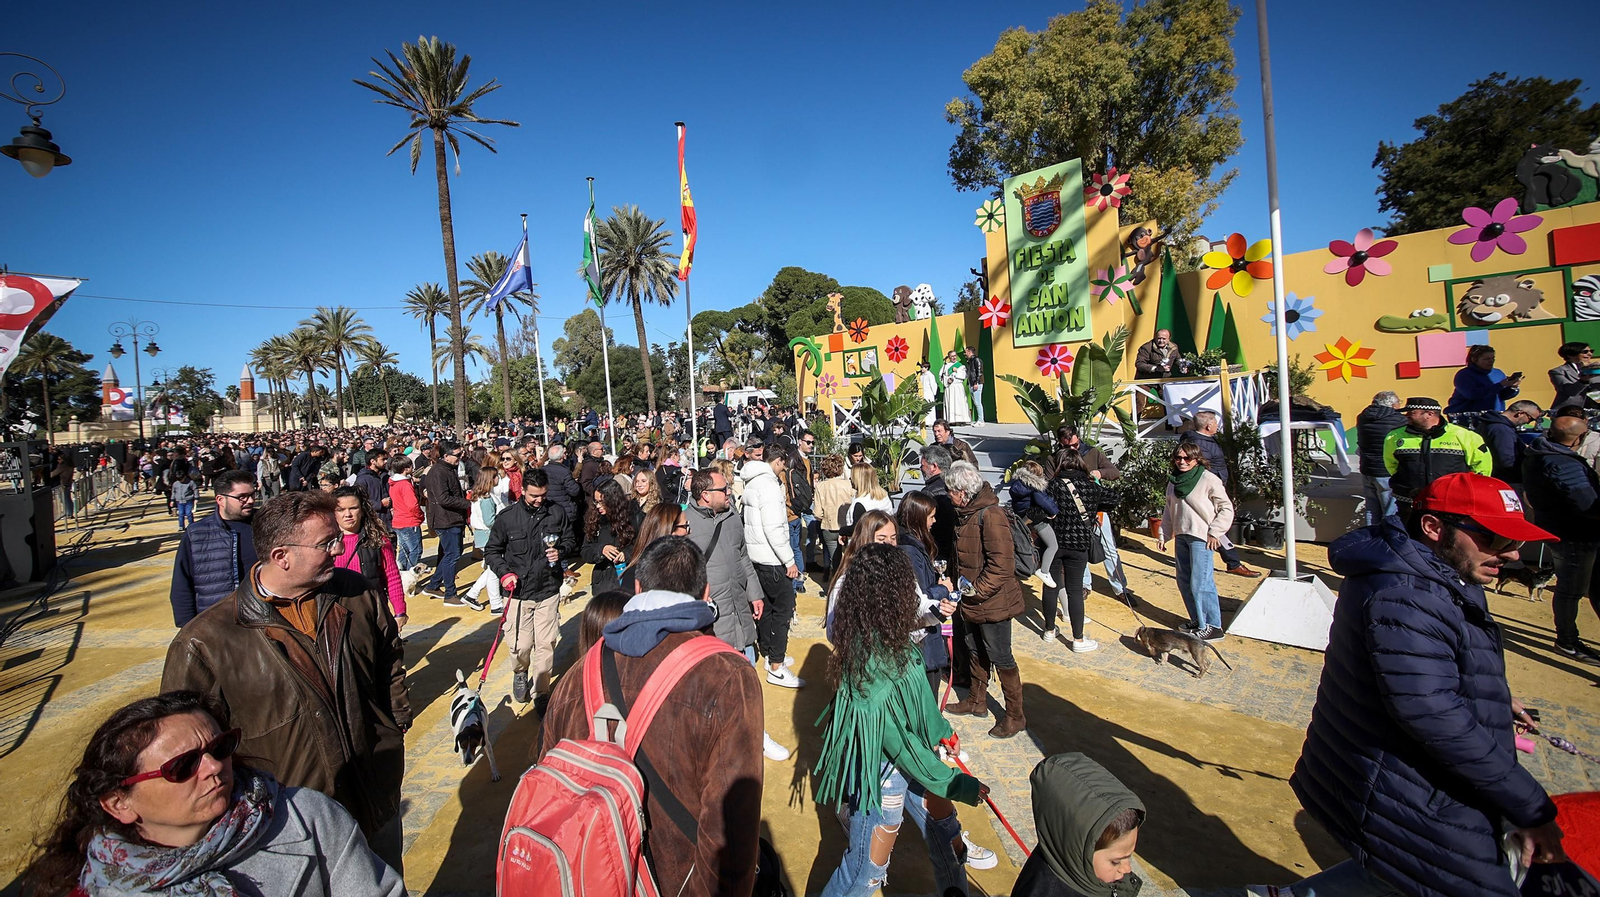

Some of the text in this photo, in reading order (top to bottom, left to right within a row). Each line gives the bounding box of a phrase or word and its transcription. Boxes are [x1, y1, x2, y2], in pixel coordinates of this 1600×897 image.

[1015, 238, 1076, 272] FIESTA
[1038, 269, 1055, 284] DE
[1028, 282, 1069, 311] SAN
[1016, 306, 1085, 336] ANTON
